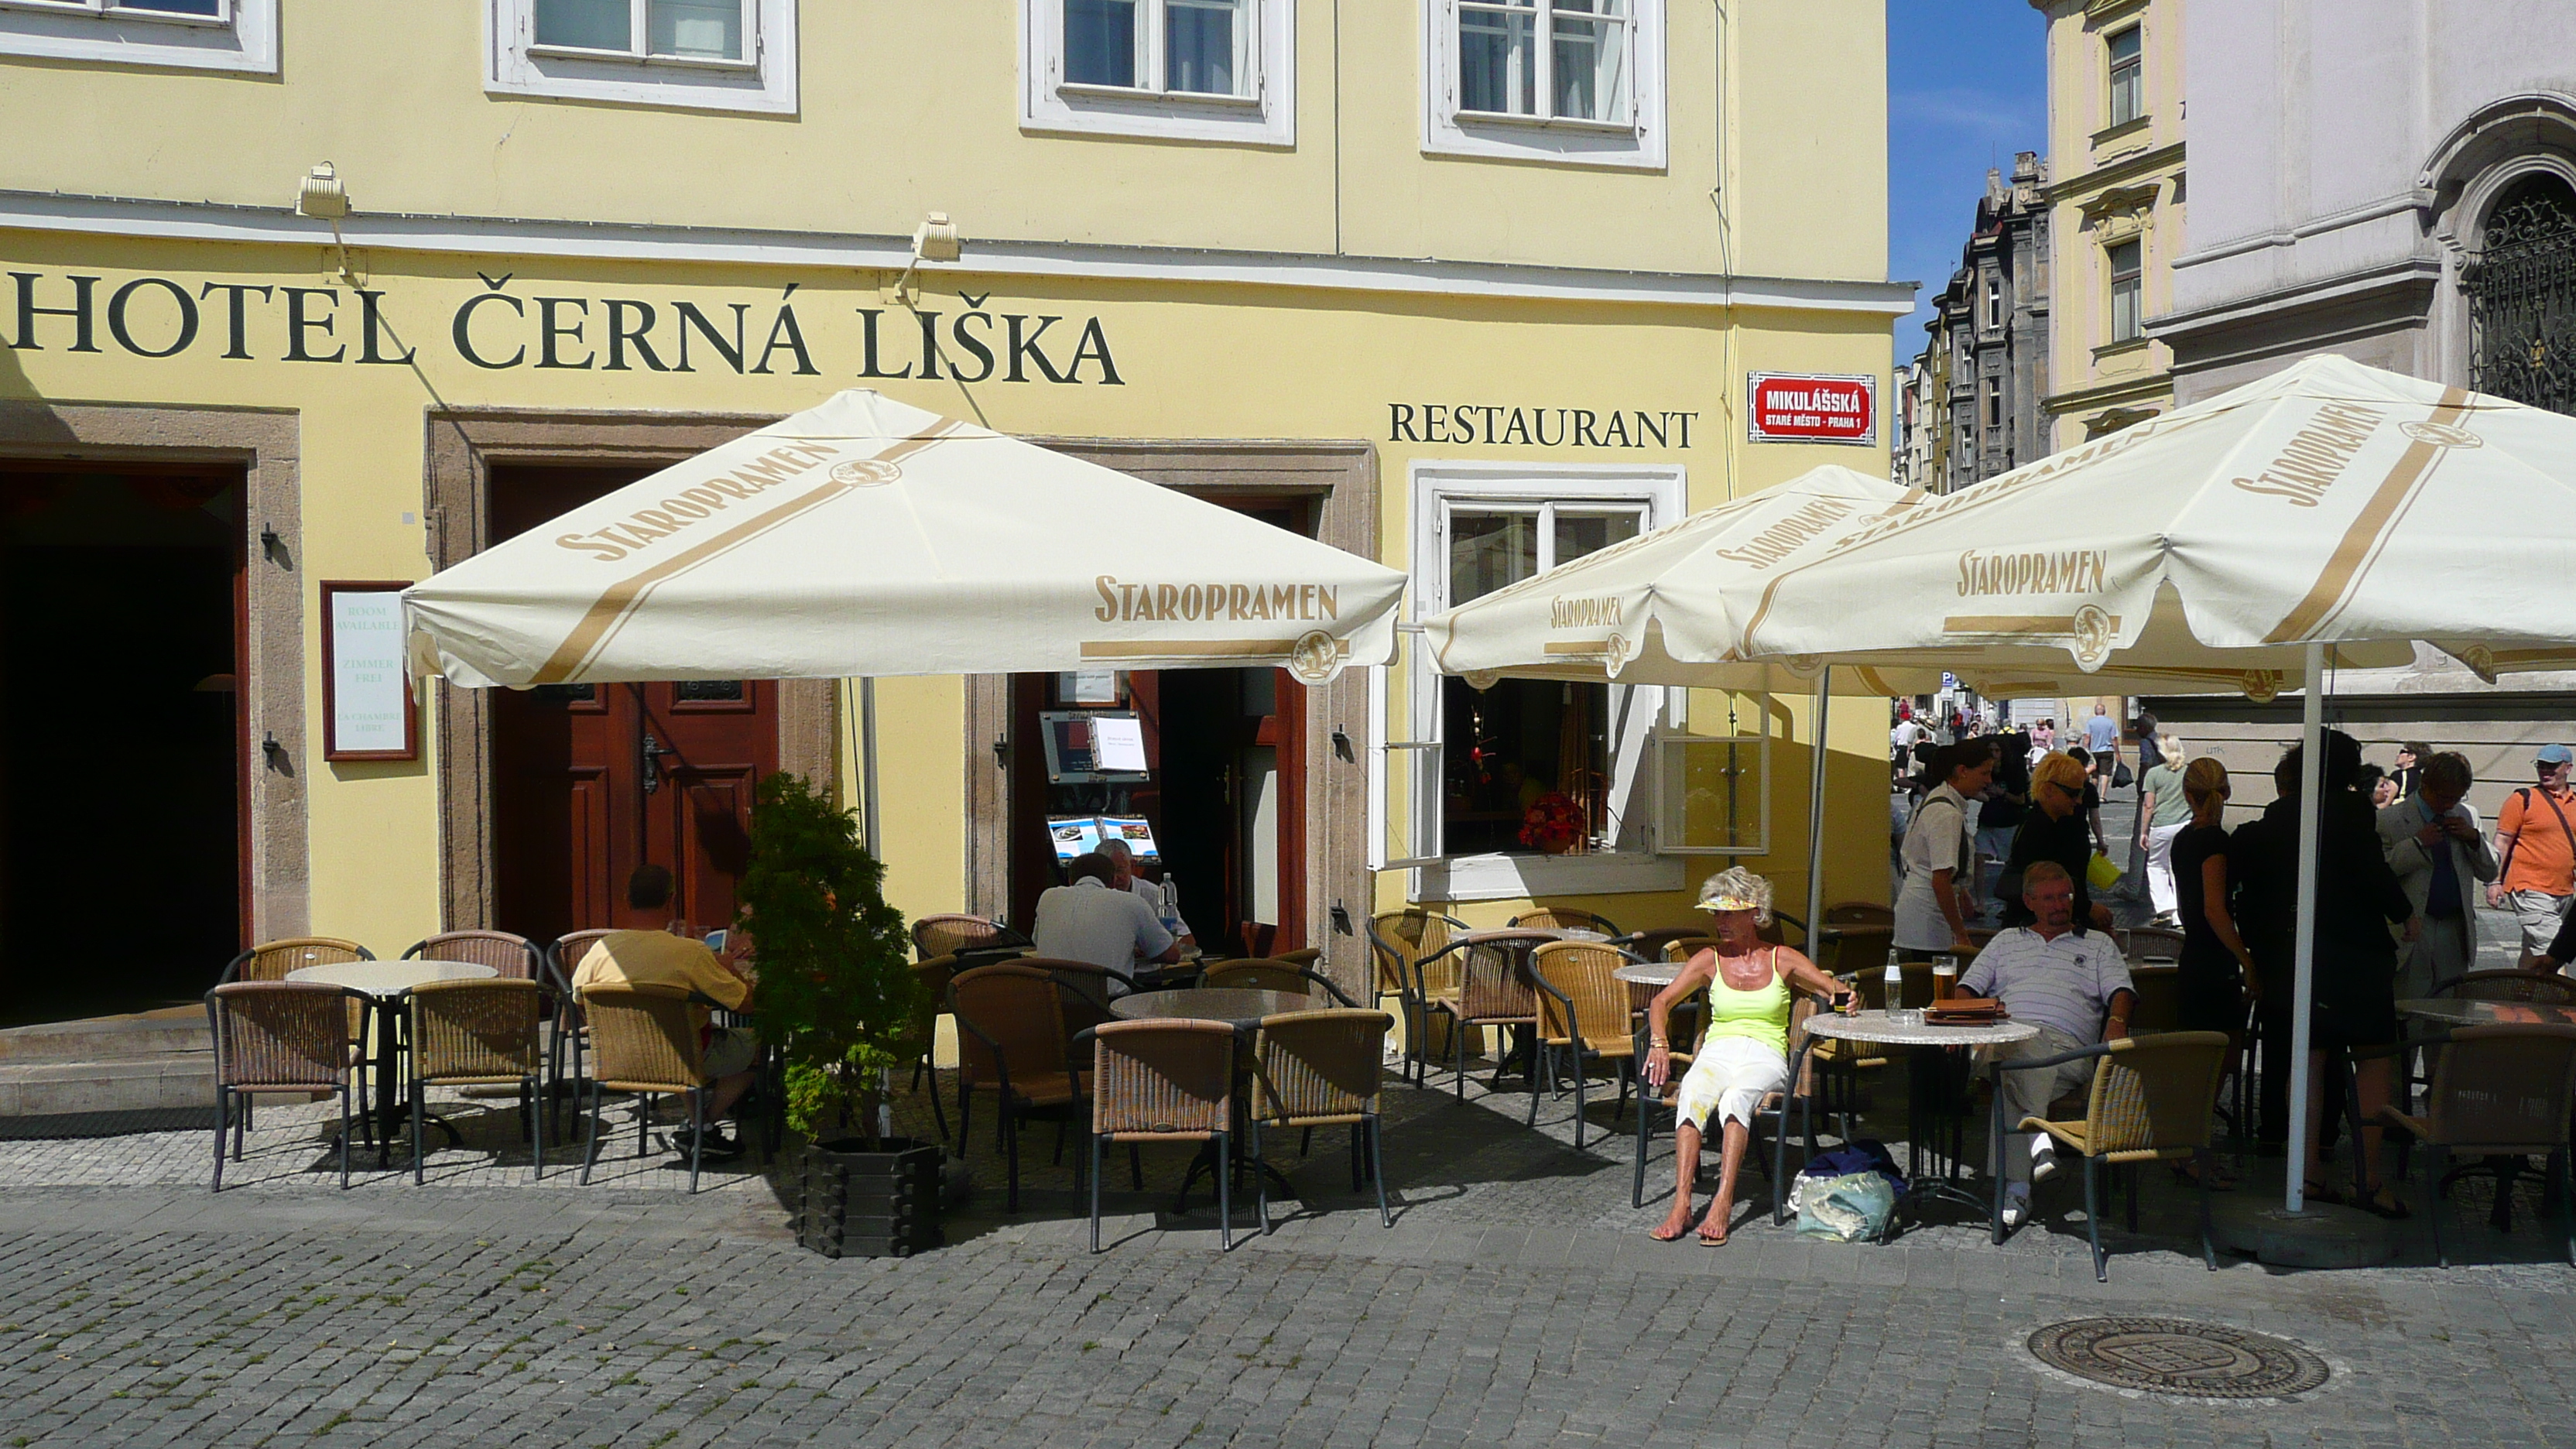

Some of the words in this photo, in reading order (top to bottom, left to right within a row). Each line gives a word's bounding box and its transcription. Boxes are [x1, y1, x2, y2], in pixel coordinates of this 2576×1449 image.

[6, 272, 416, 365] HOTEL
[452, 271, 821, 376] ČERNÁ
[856, 290, 1125, 386] LIŠKA
[1766, 388, 1860, 413] MIKULÁŠSKÁ
[1389, 403, 1699, 449] RESTAURANT
[1766, 413, 1792, 426] STARÉ
[1793, 413, 1821, 427] MĚSTO
[1828, 416, 1854, 428] PRAHA
[1856, 418, 1861, 428] 1
[2232, 399, 2387, 508] STAROPRAMEN
[555, 440, 840, 562] STAROPRAMEN
[1716, 496, 1856, 570] STAROPRAMEN
[1957, 550, 2107, 597] STAROPRAMEN
[348, 607, 386, 616] ROOM
[1094, 575, 1338, 622] STAROPRAMEN
[1551, 595, 1624, 629] STAROPRAMEN
[336, 621, 399, 631] AVAILABLE
[343, 659, 394, 669] ZIMMER
[355, 673, 382, 683] FREI
[1942, 671, 1951, 683] P
[355, 724, 385, 732] LIBRE
